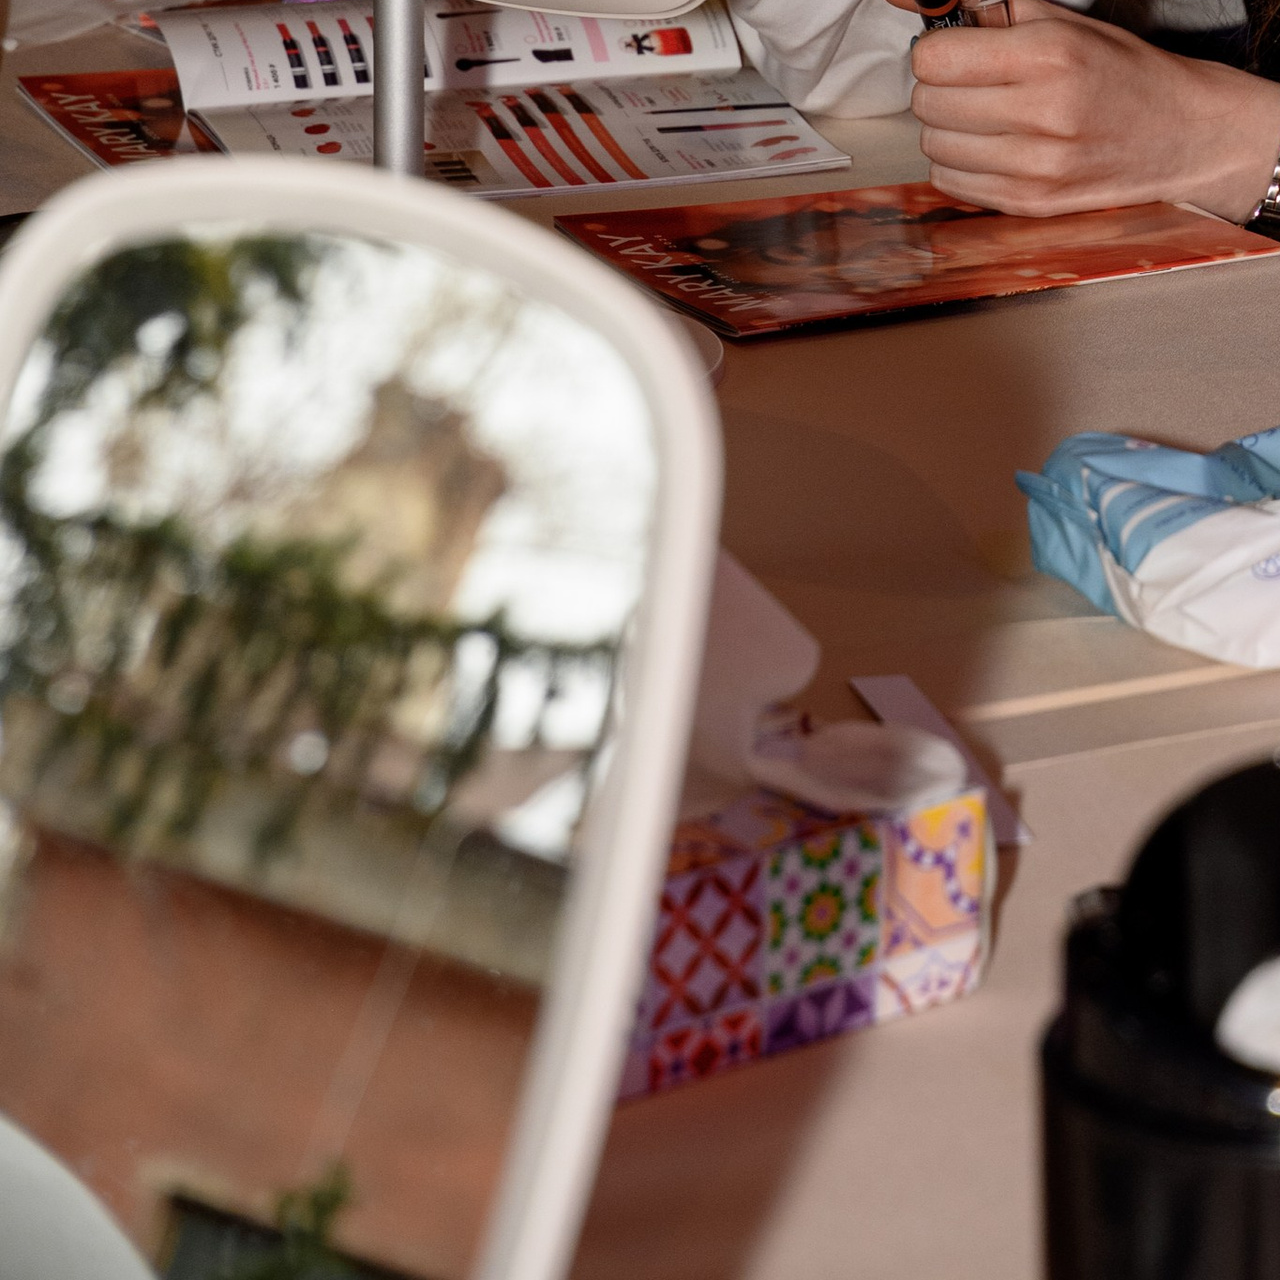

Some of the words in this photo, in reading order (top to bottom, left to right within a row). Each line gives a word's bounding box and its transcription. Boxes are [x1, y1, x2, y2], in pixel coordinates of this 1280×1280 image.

[50, 92, 118, 123] KAY
[596, 233, 685, 270] KAY
[654, 273, 771, 313] MARY
